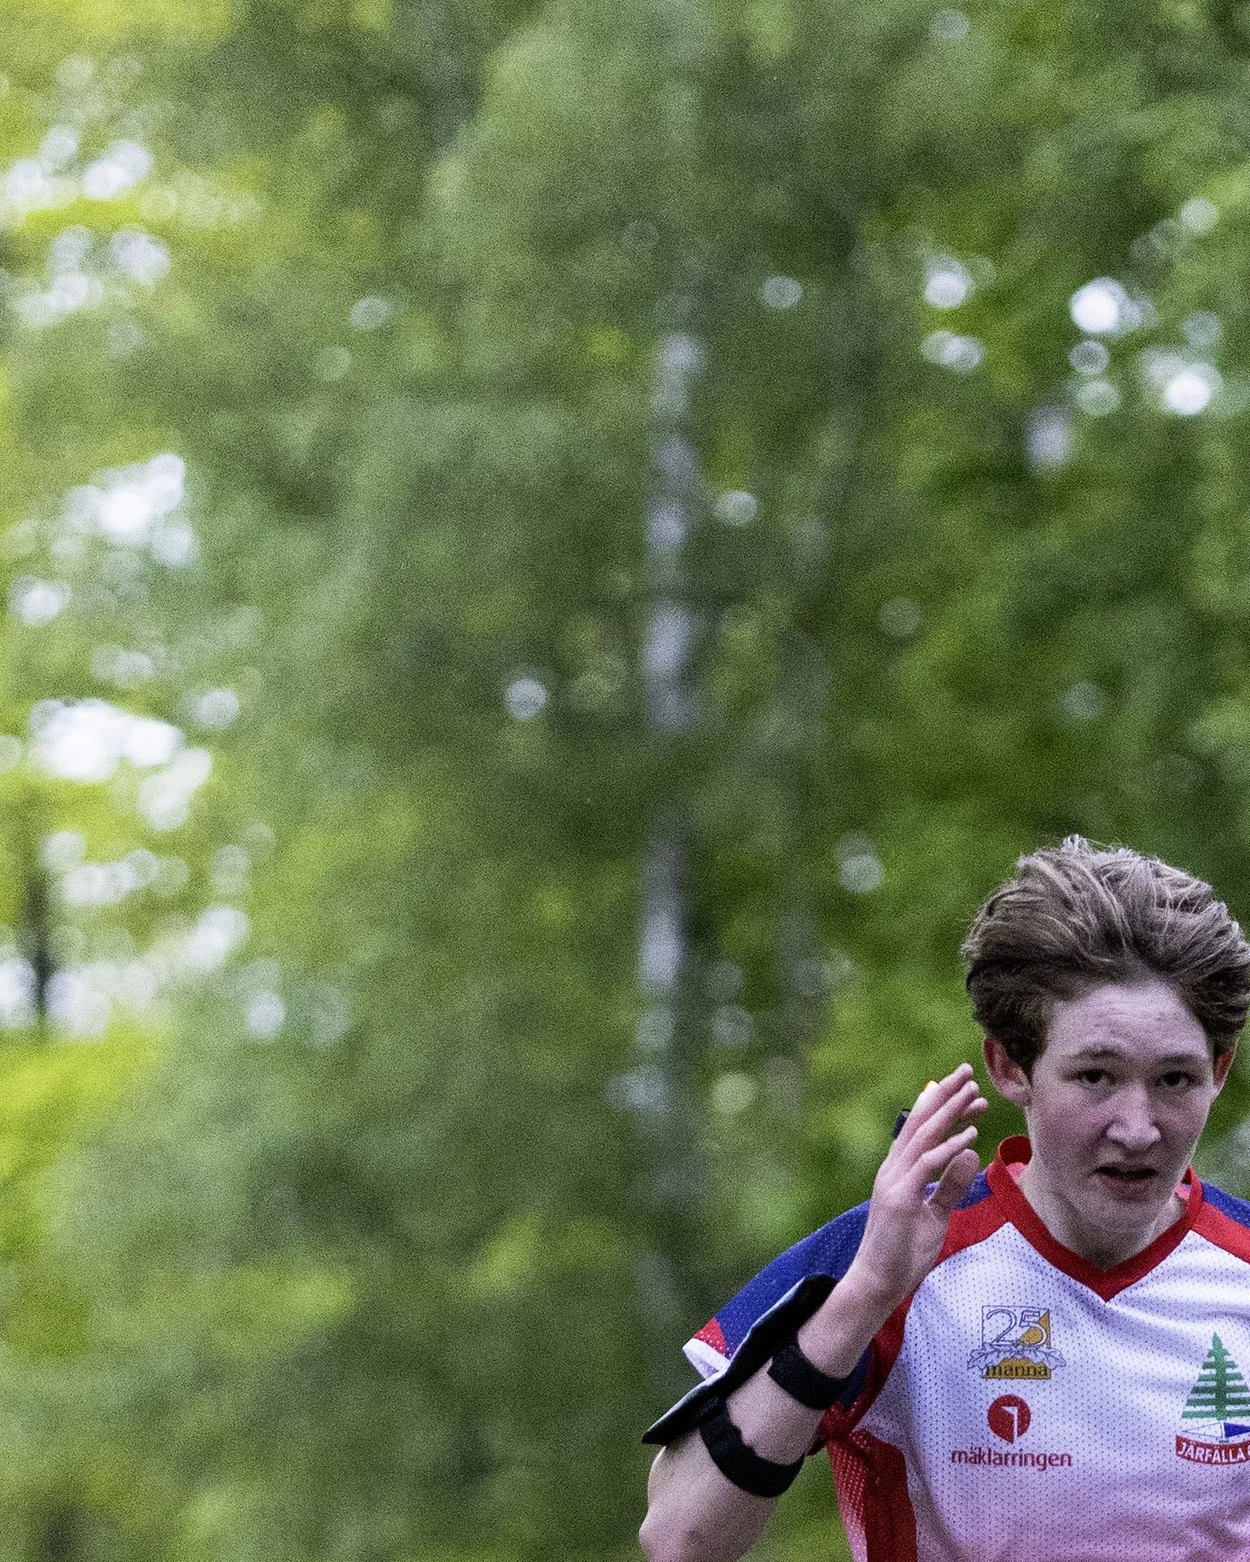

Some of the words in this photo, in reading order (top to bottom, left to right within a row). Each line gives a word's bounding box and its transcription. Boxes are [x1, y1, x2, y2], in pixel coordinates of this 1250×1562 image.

[986, 1308, 1048, 1349] 25
[985, 1364, 1048, 1377] manna
[951, 1446, 1073, 1471] mäklarringen
[1177, 1441, 1246, 1463] JÄRFÄLLA
